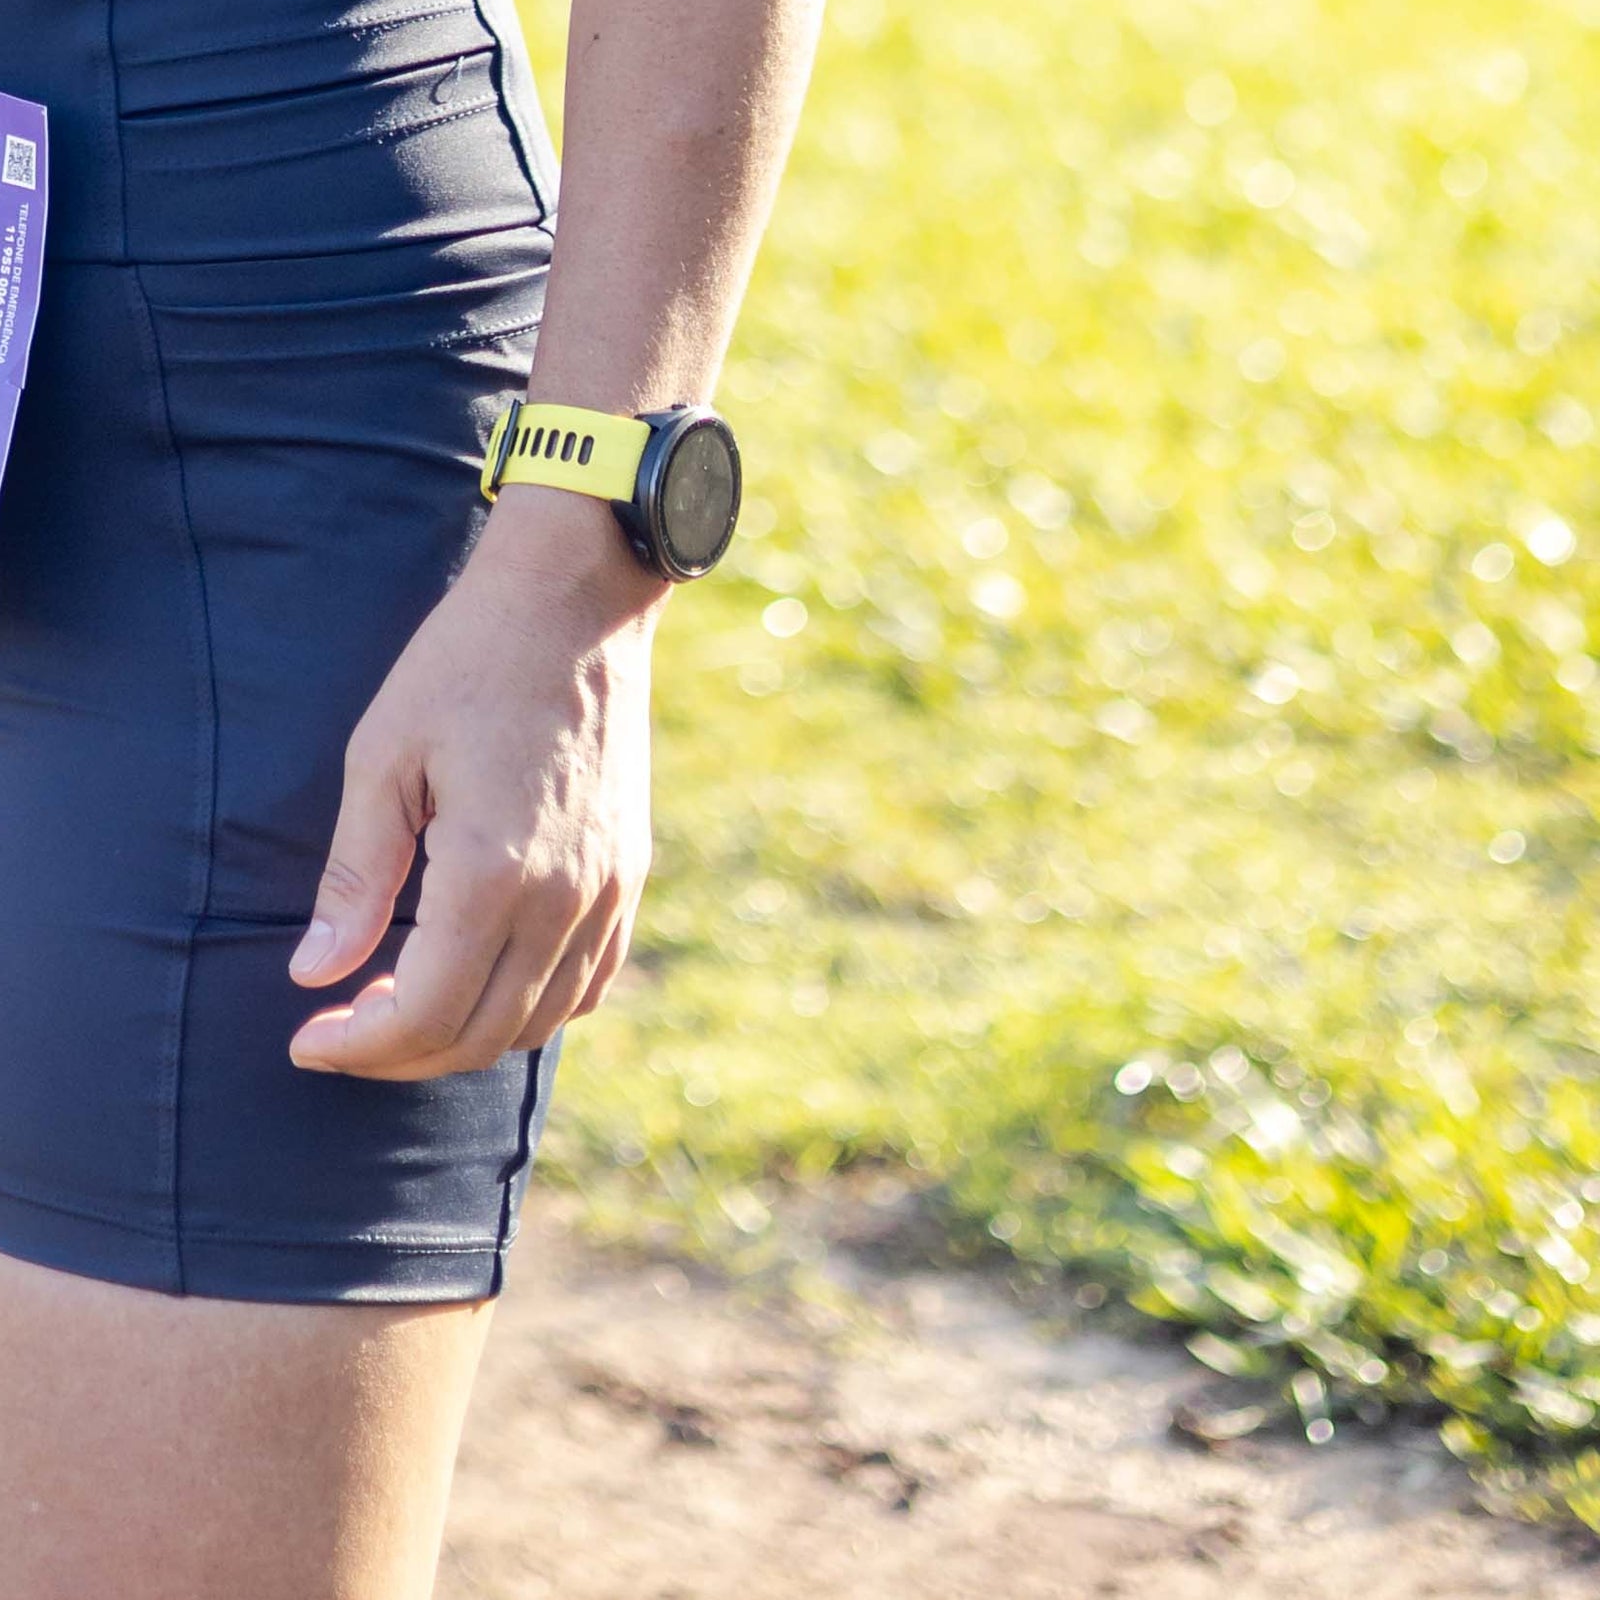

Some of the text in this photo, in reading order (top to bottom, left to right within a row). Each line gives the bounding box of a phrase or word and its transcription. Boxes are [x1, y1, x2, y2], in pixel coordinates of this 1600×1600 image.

[4, 225, 16, 243] 11
[12, 202, 29, 265] TELEFONE
[0, 246, 13, 275] 955
[11, 266, 22, 285] DE
